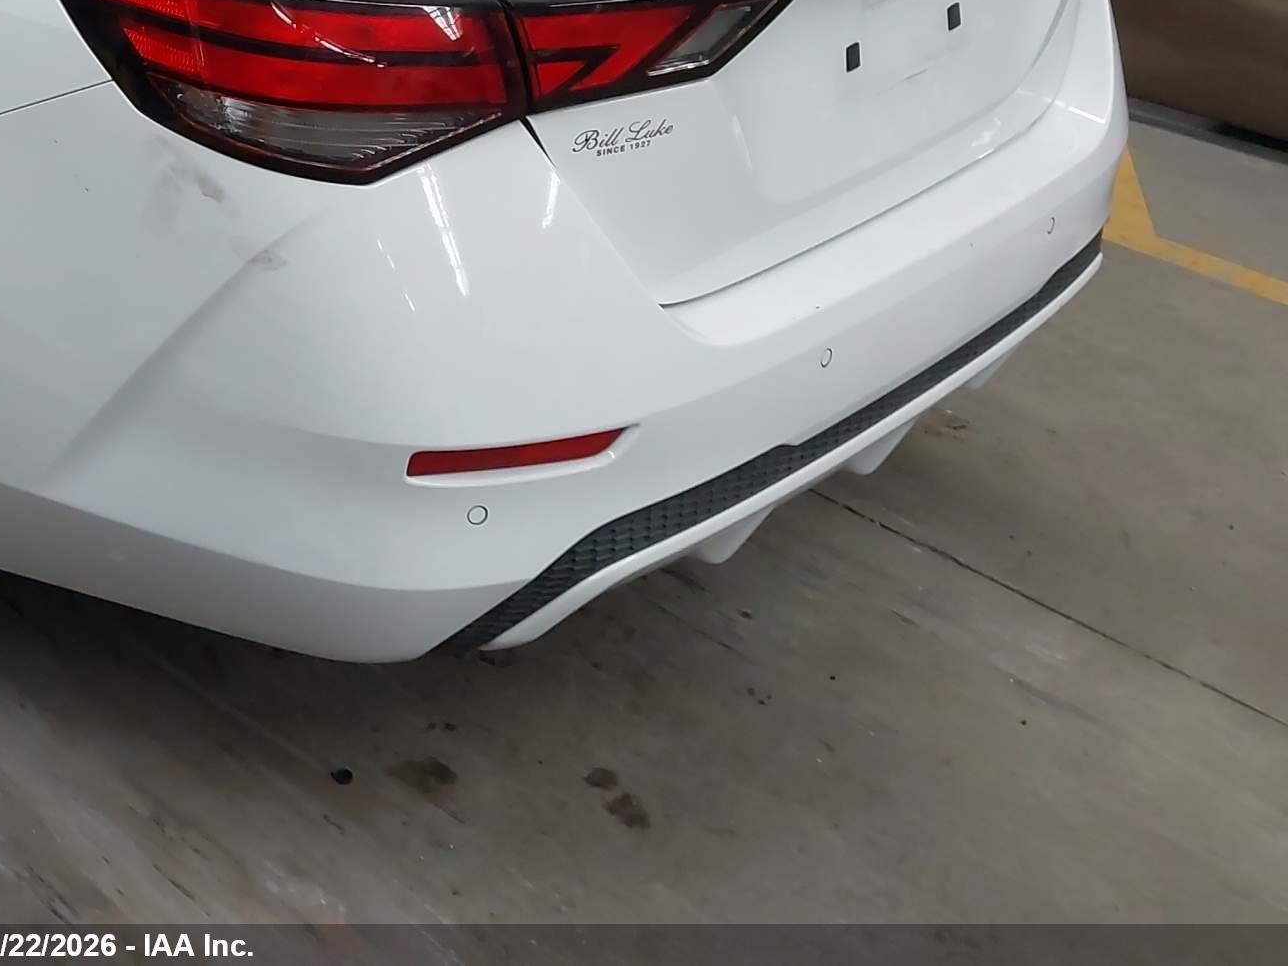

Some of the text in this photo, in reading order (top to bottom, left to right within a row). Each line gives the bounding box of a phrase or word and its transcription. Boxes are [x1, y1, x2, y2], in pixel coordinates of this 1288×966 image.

[572, 118, 674, 153] Bill Luke
[596, 139, 652, 157] SINCE 1927
